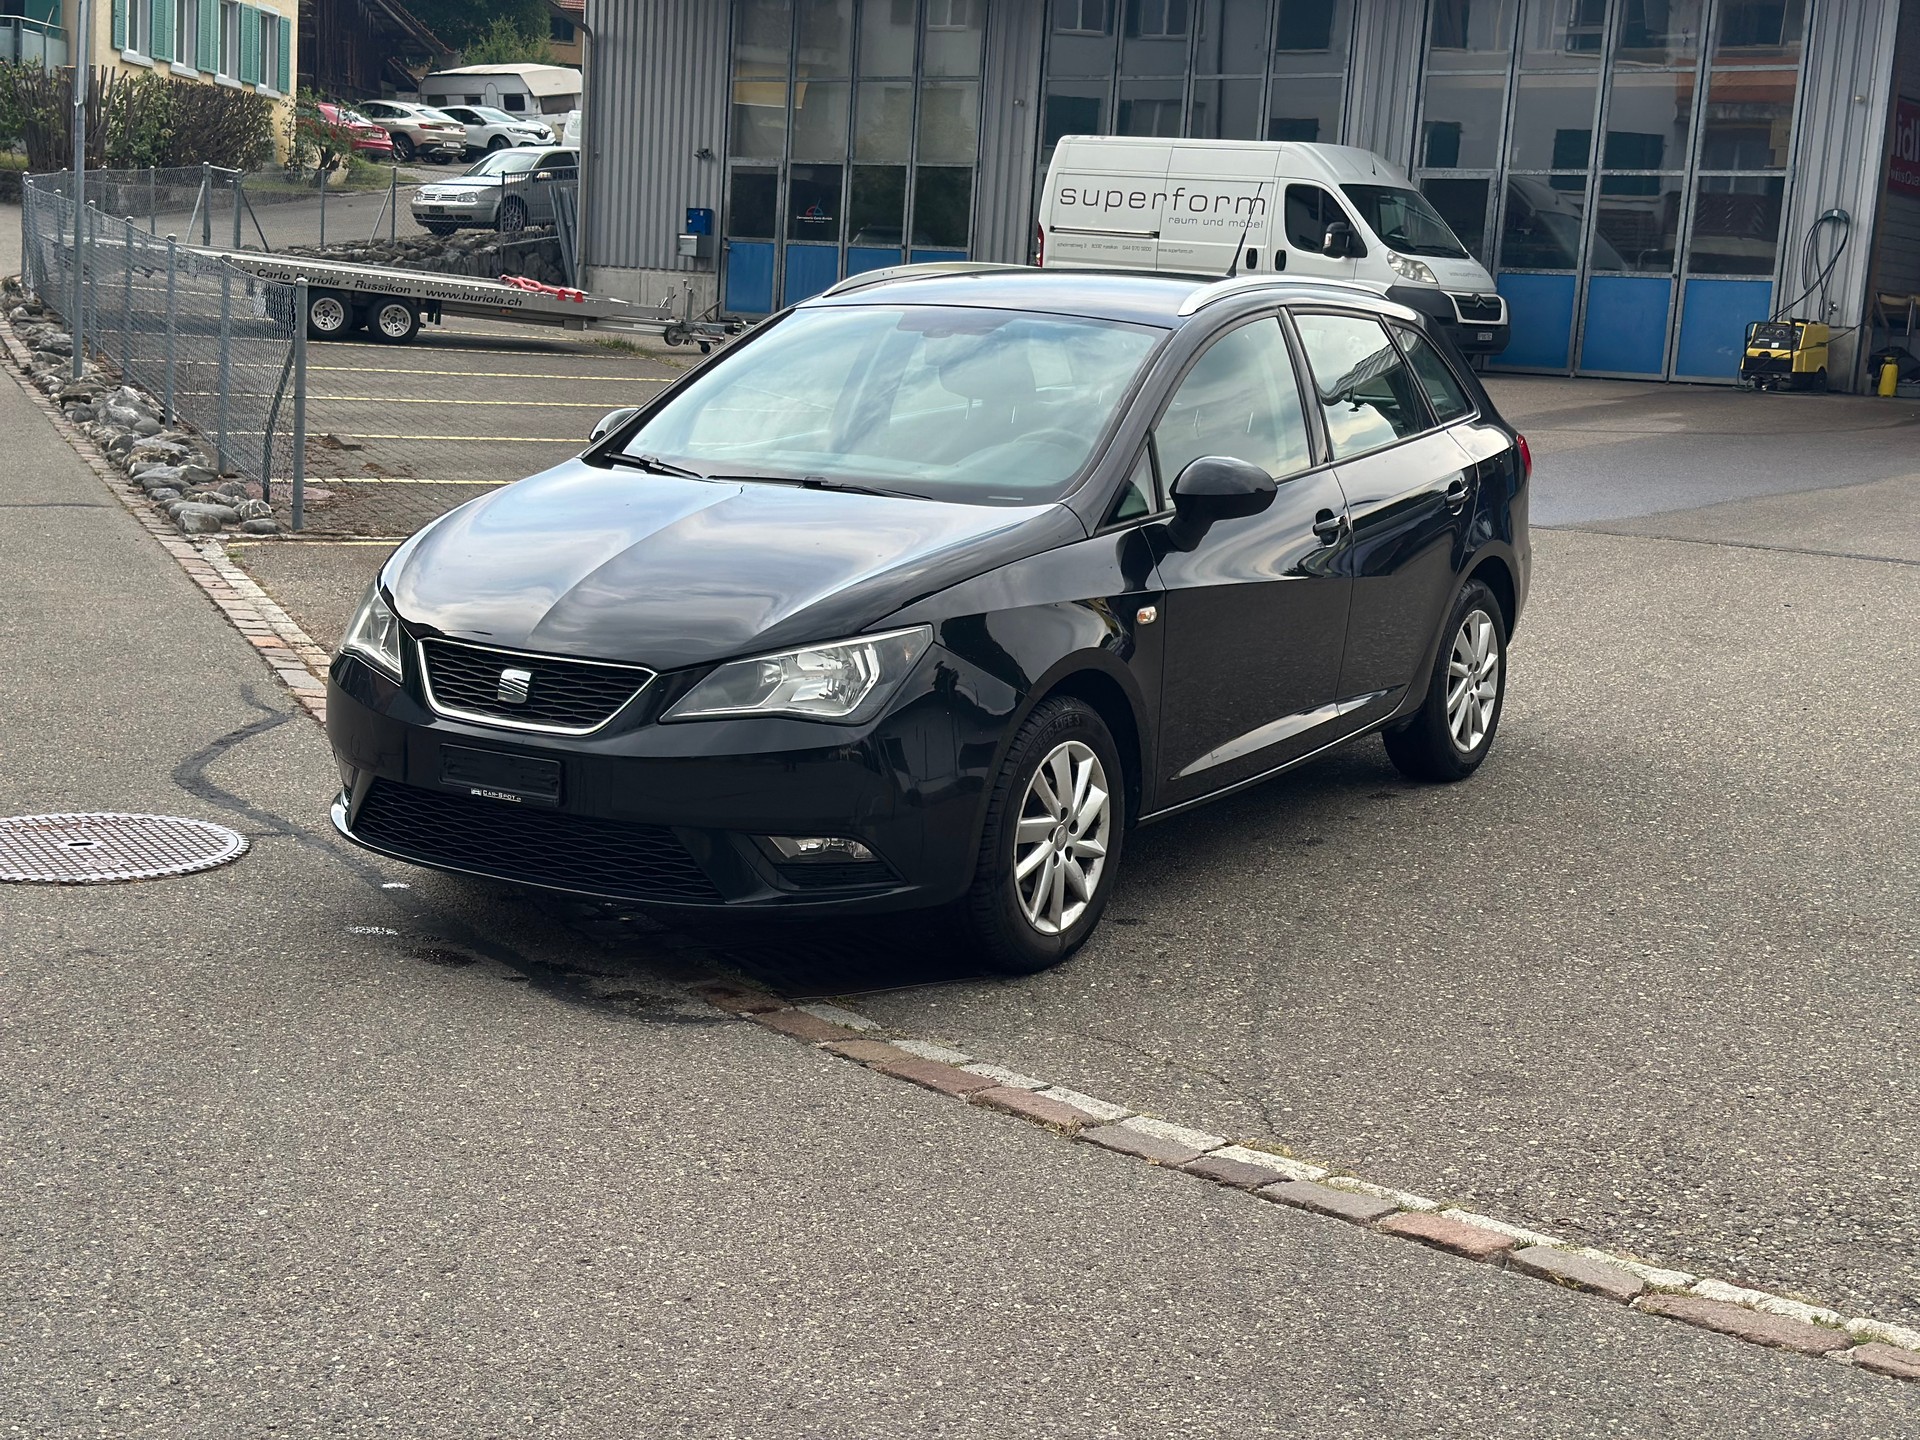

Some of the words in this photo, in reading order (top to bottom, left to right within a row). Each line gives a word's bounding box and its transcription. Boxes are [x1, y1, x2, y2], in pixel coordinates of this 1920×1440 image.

[1059, 187, 1266, 216] superform
[1168, 216, 1198, 225] raum
[1202, 217, 1224, 227] und
[257, 268, 291, 281] Carlo
[354, 280, 411, 294] Russikon
[425, 289, 523, 307] www.buriola.ch
